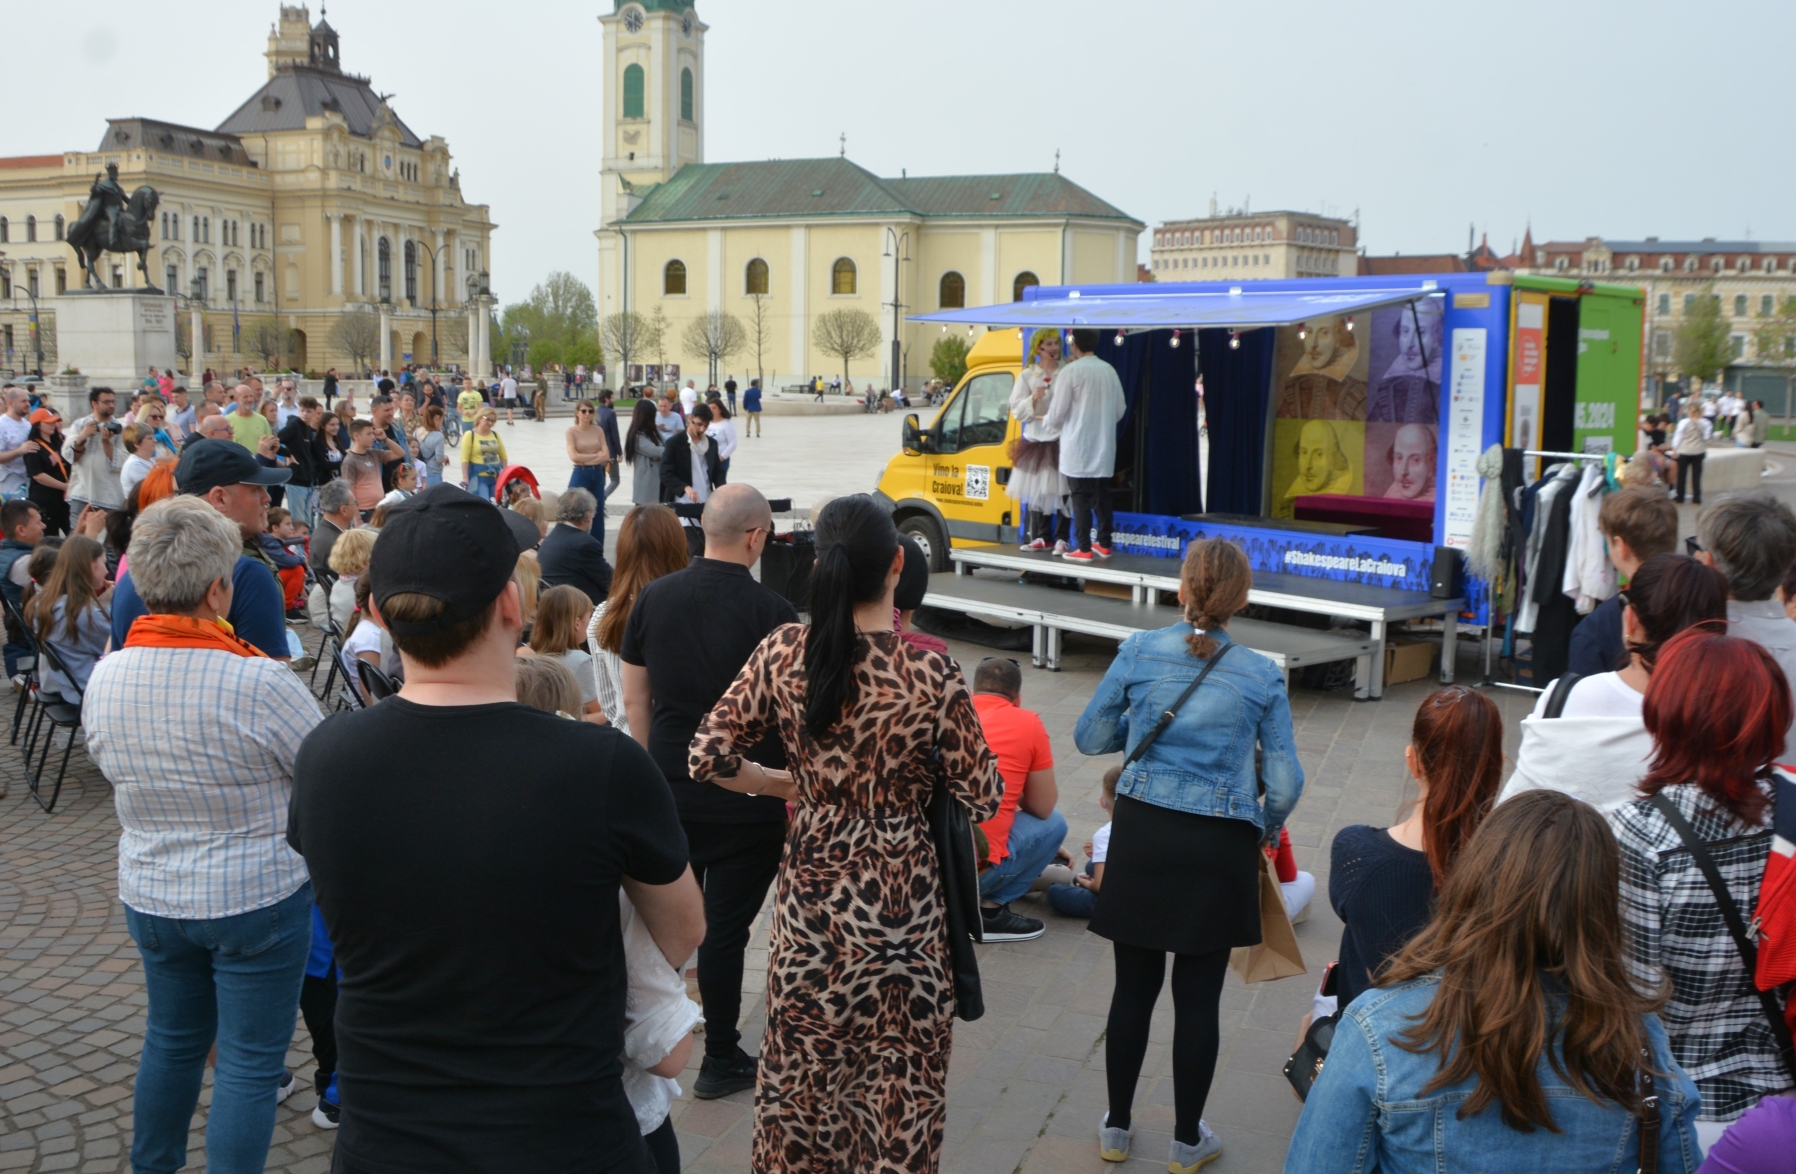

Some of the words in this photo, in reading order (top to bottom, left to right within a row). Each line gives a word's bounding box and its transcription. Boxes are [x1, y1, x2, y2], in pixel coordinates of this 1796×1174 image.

[933, 463, 950, 477] Vino
[951, 465, 959, 478] la
[932, 480, 964, 496] Craiova!
[1284, 550, 1407, 577] #ShakespeareLaCraiova
